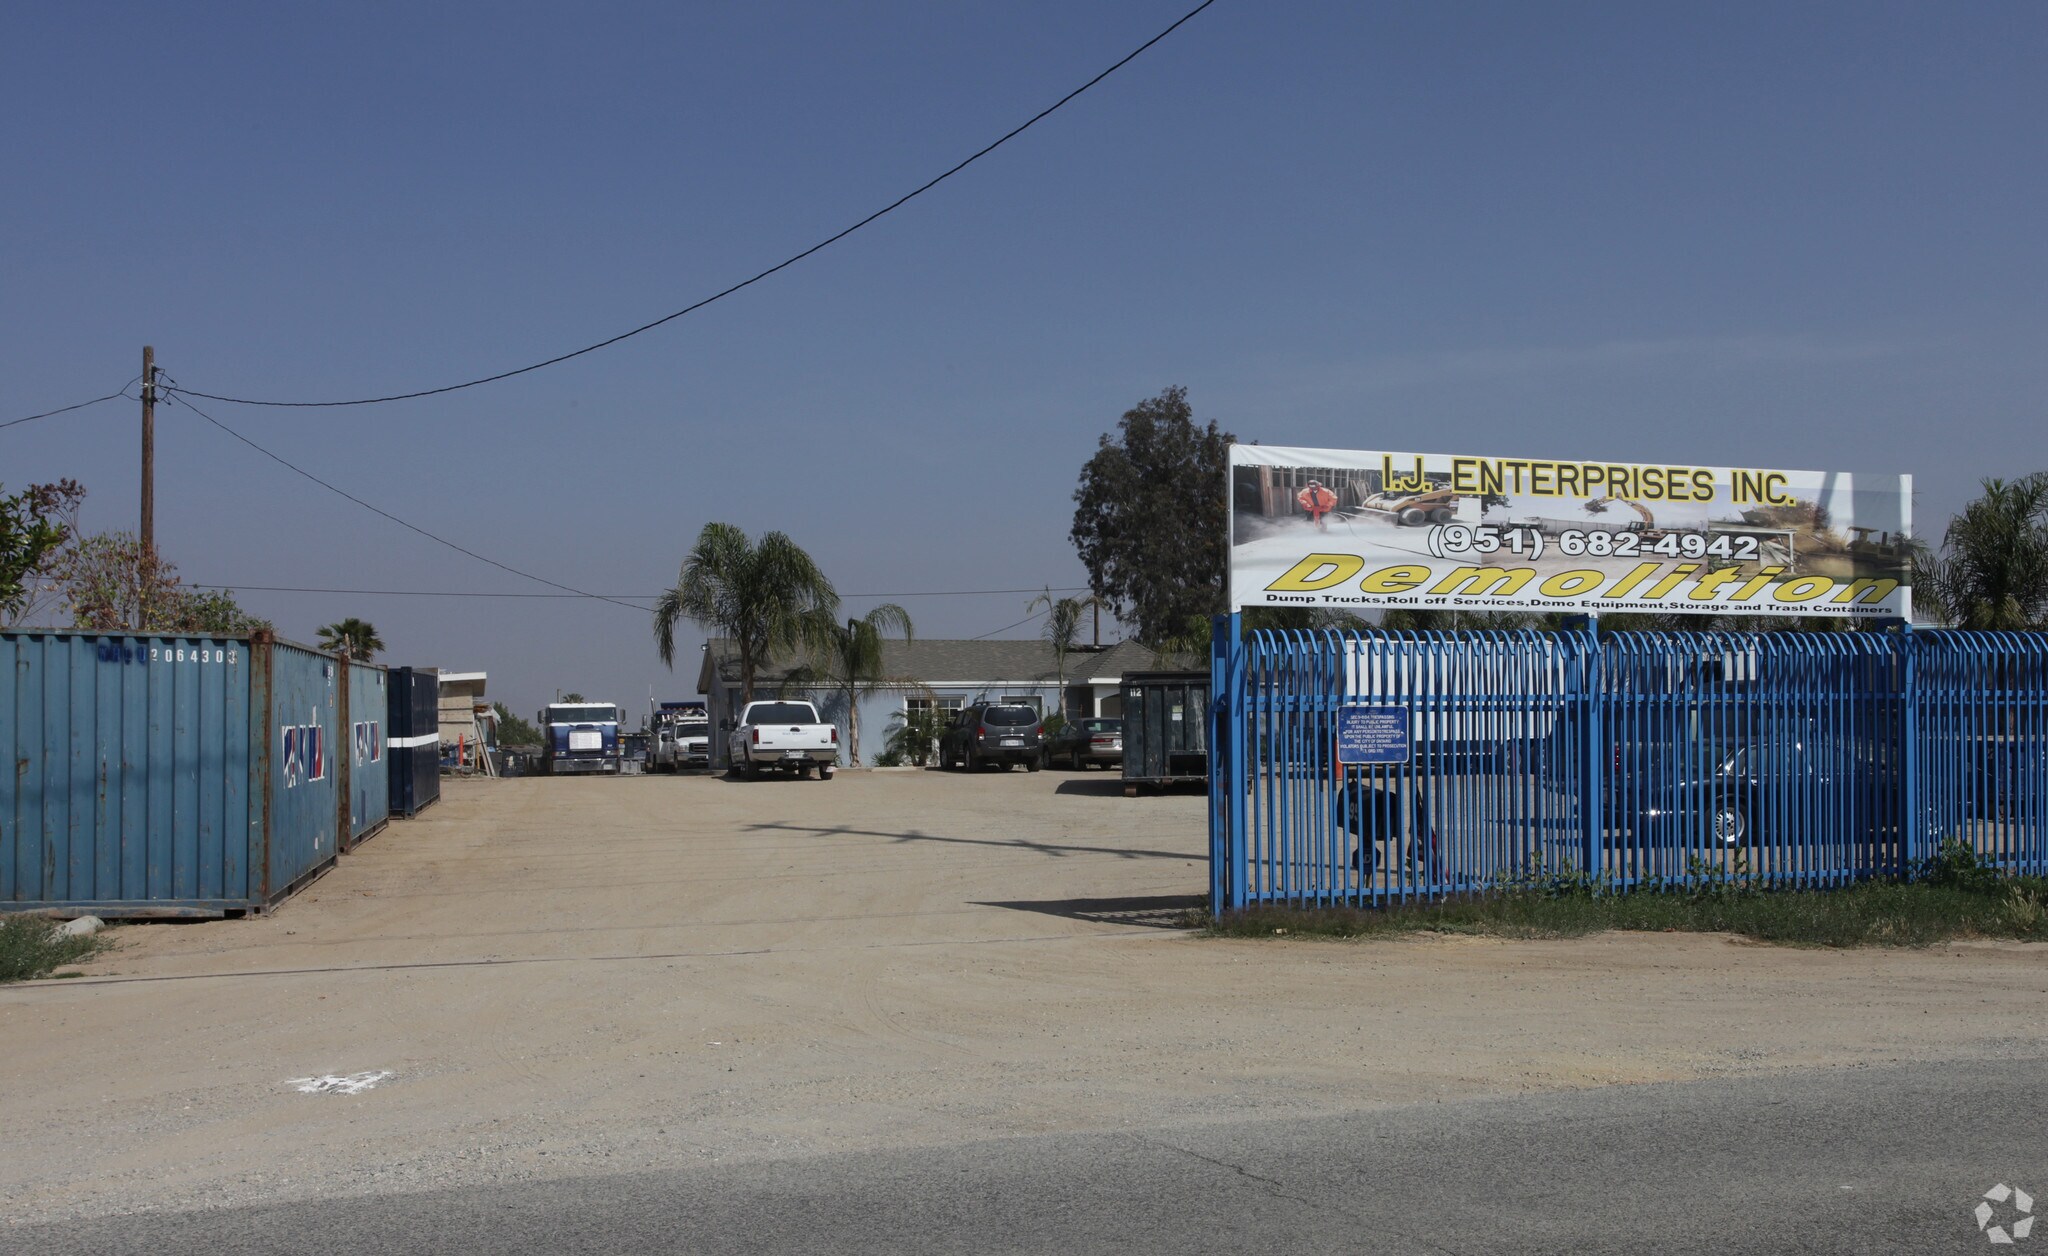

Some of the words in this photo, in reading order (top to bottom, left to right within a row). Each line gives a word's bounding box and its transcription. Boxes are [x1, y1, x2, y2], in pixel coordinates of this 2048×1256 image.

[1382, 454, 1432, 492] I.J.
[1452, 457, 1715, 502] ENTERPRISES
[1730, 470, 1796, 506] INC.
[1428, 524, 1544, 561] (951)
[1559, 528, 1760, 560] 682-4942
[1264, 552, 1898, 604] Demolition
[1266, 594, 1316, 604] Dump
[1424, 596, 1446, 605] off
[1813, 605, 1892, 614] Containers
[1130, 688, 1142, 697] 112
